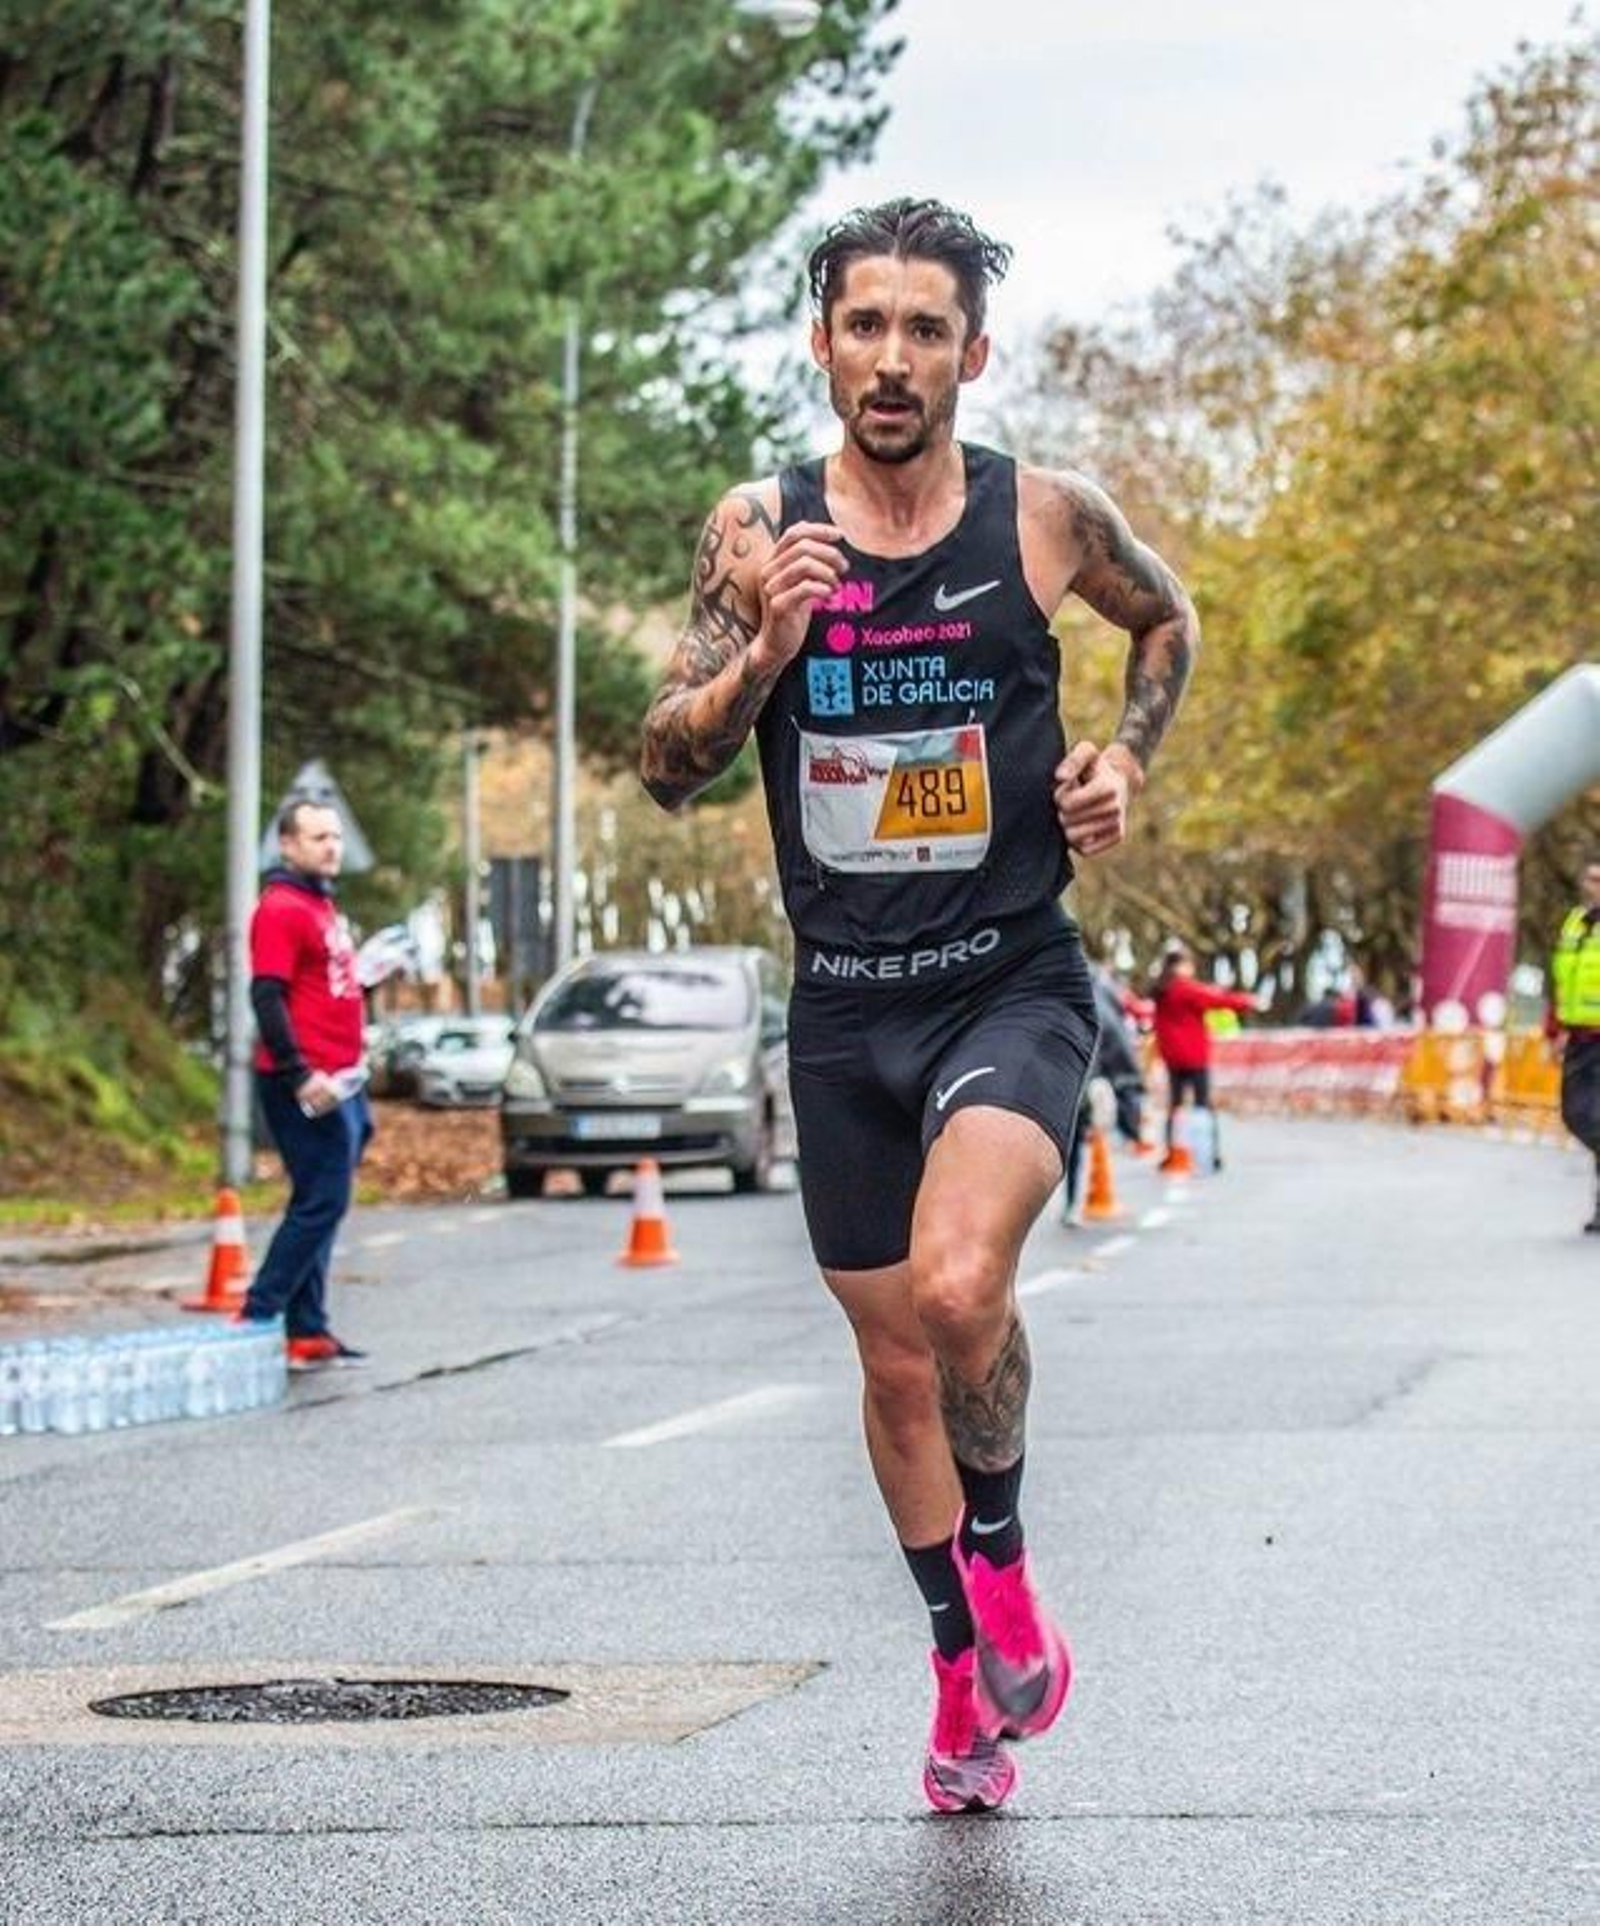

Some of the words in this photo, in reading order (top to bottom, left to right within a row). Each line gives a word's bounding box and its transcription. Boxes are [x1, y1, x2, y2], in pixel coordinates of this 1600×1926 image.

[861, 625, 934, 645] Xacobeo
[939, 622, 972, 640] 2021
[862, 656, 946, 682] XUNTA
[862, 684, 893, 706] DE
[899, 680, 995, 705] GALICIA
[896, 768, 966, 818] 489
[811, 951, 905, 979] NIKE
[909, 928, 1001, 976] PRO
